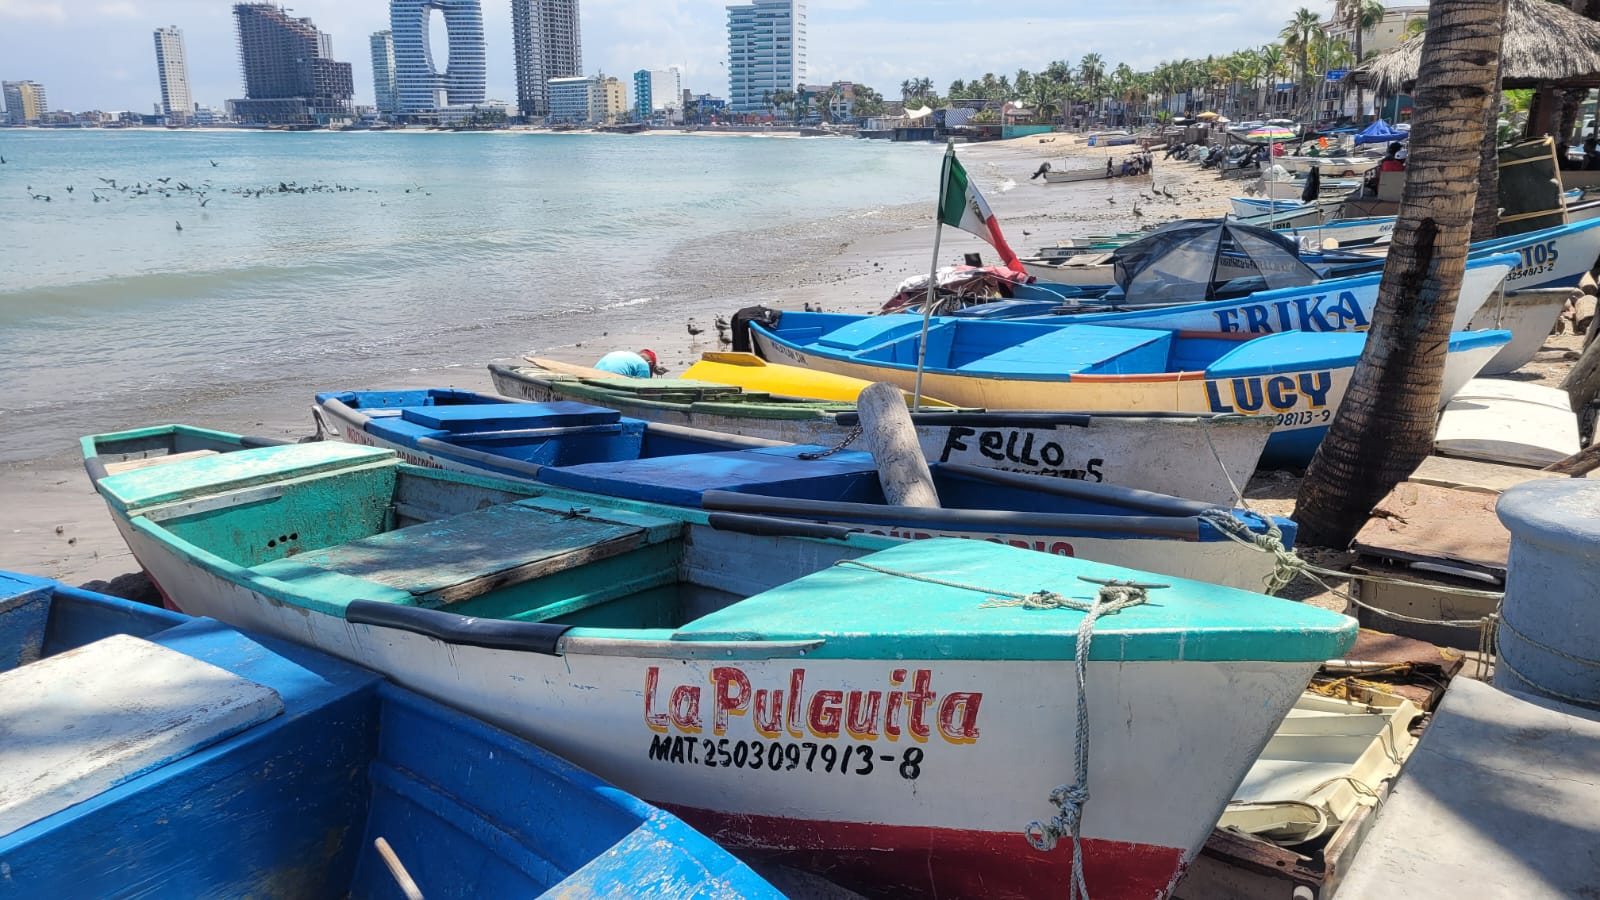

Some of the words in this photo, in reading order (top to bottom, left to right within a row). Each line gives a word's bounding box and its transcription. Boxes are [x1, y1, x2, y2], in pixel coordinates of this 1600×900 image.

[1212, 291, 1370, 332] ERIKA
[1203, 371, 1331, 416] LUCY
[644, 666, 703, 733] La
